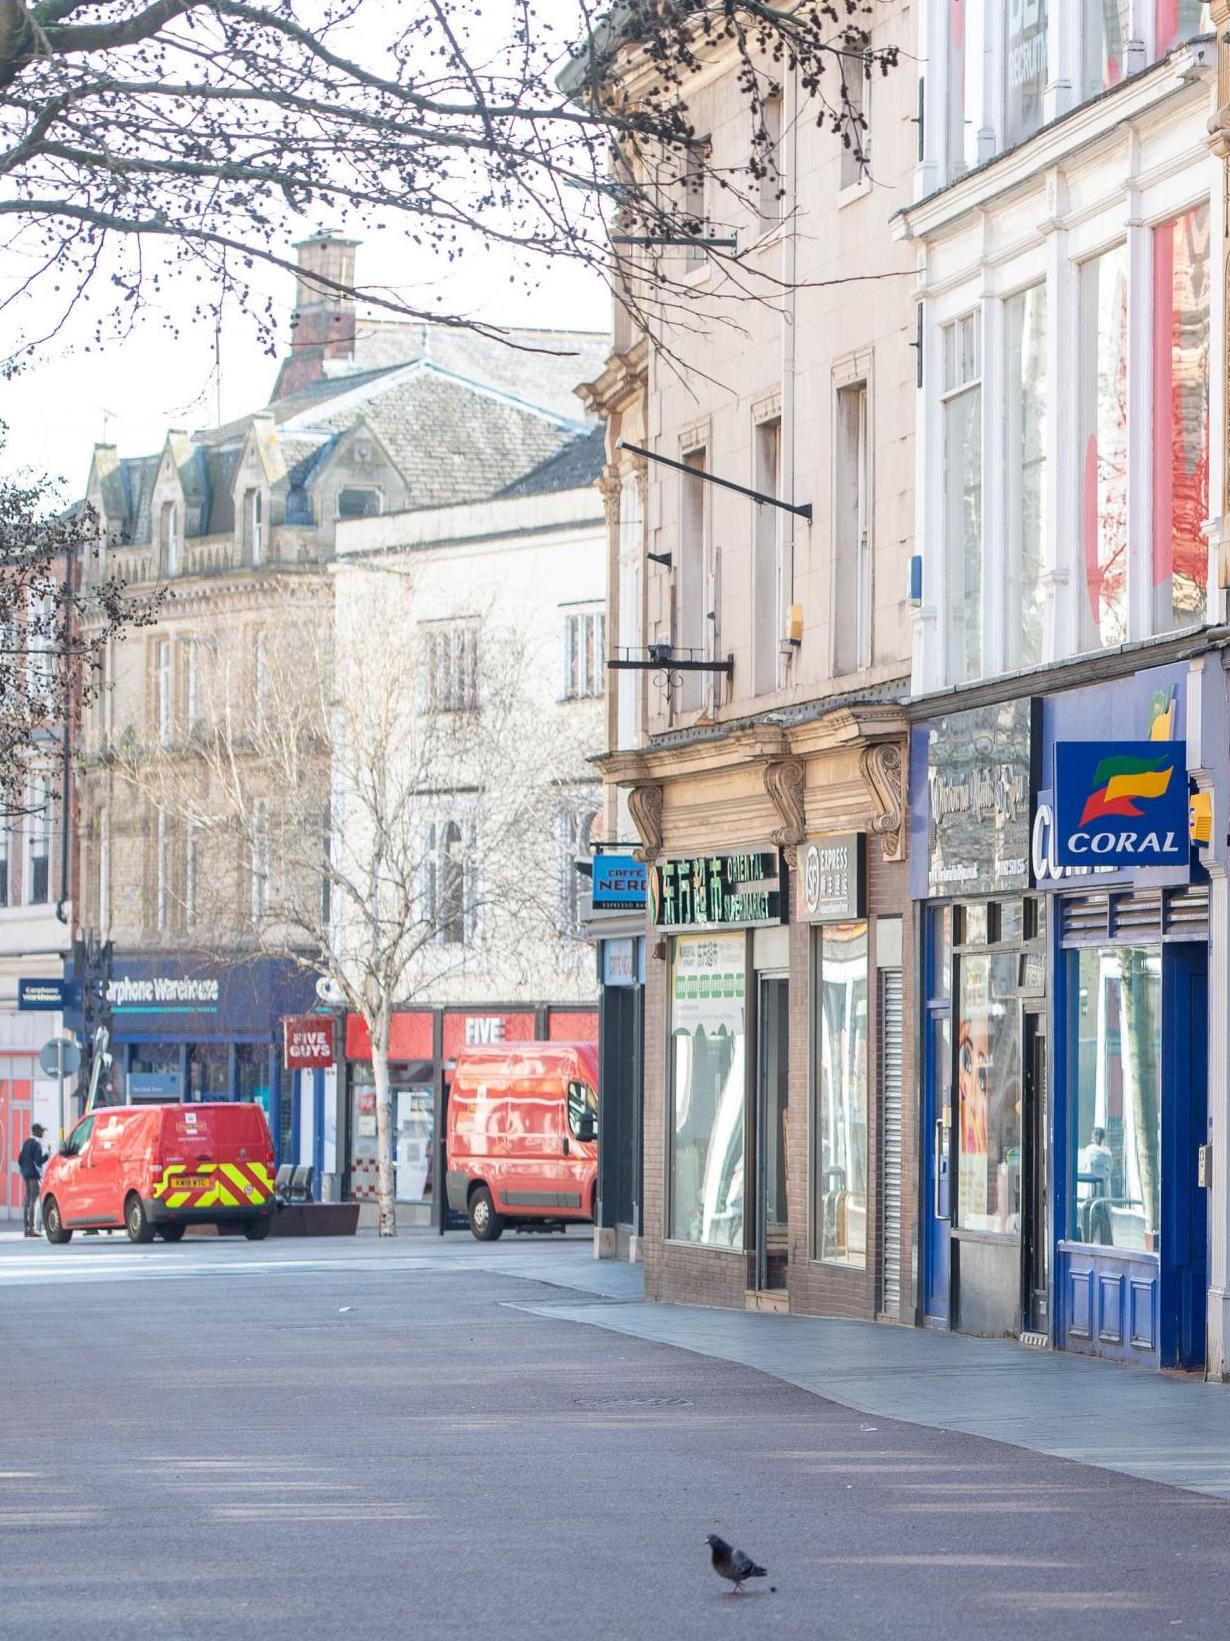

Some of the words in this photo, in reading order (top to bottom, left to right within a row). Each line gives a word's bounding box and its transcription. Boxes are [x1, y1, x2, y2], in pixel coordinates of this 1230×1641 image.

[1067, 832, 1179, 853] CORAL
[727, 853, 764, 884] ORIENTAL
[821, 846, 848, 871] EXPRESS
[724, 890, 769, 921] SUPERMARKET
[153, 975, 219, 1002] Warehouse
[293, 1032, 326, 1045] FIVE
[465, 1017, 505, 1044] FIVE
[290, 1045, 330, 1057] GUYS
